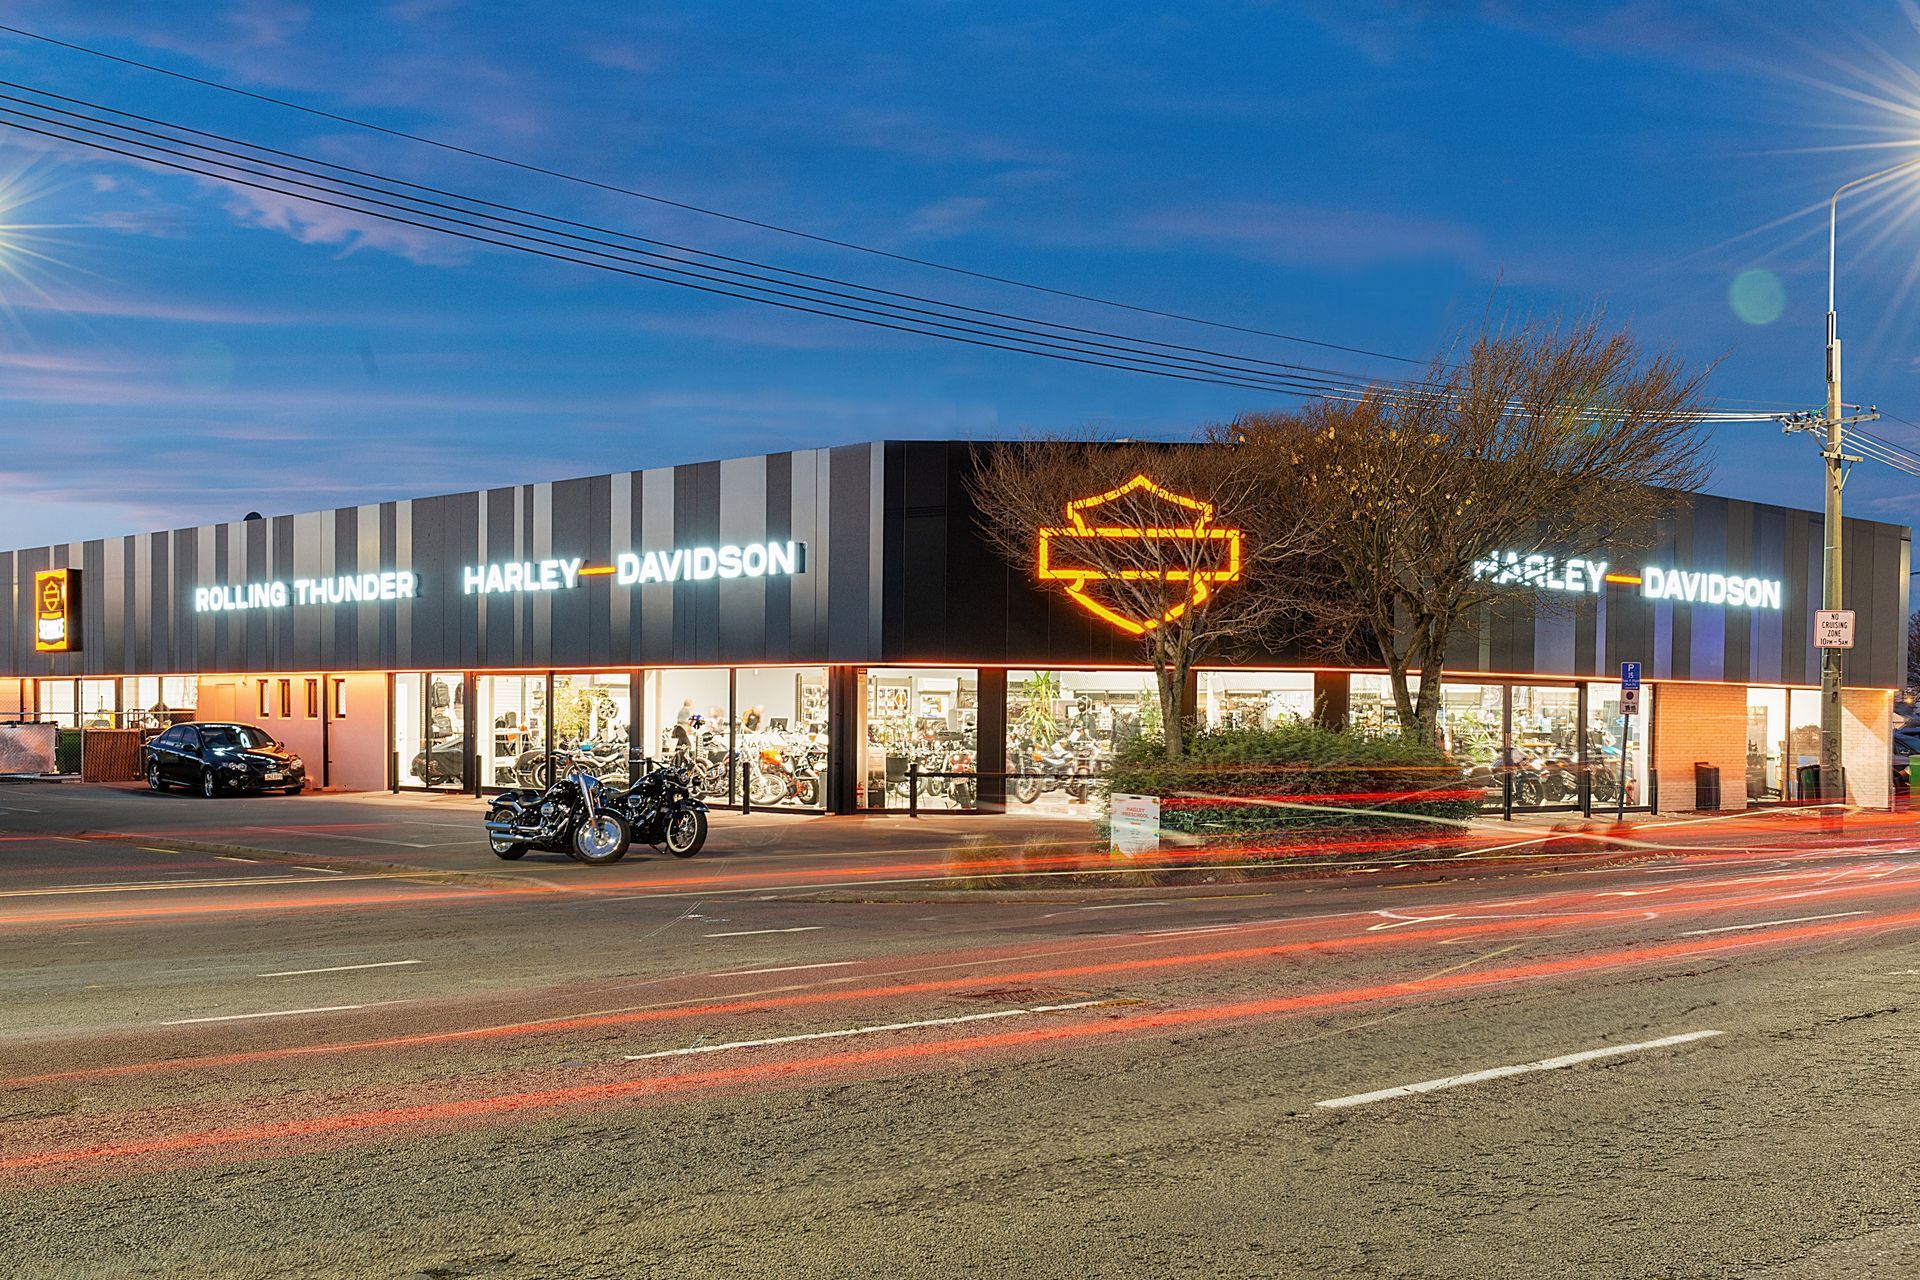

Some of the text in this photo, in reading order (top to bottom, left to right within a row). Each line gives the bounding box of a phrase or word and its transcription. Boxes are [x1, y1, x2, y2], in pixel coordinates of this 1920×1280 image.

[195, 571, 415, 612] ROLLING THUNDER
[1822, 621, 1847, 629] CRUISING
